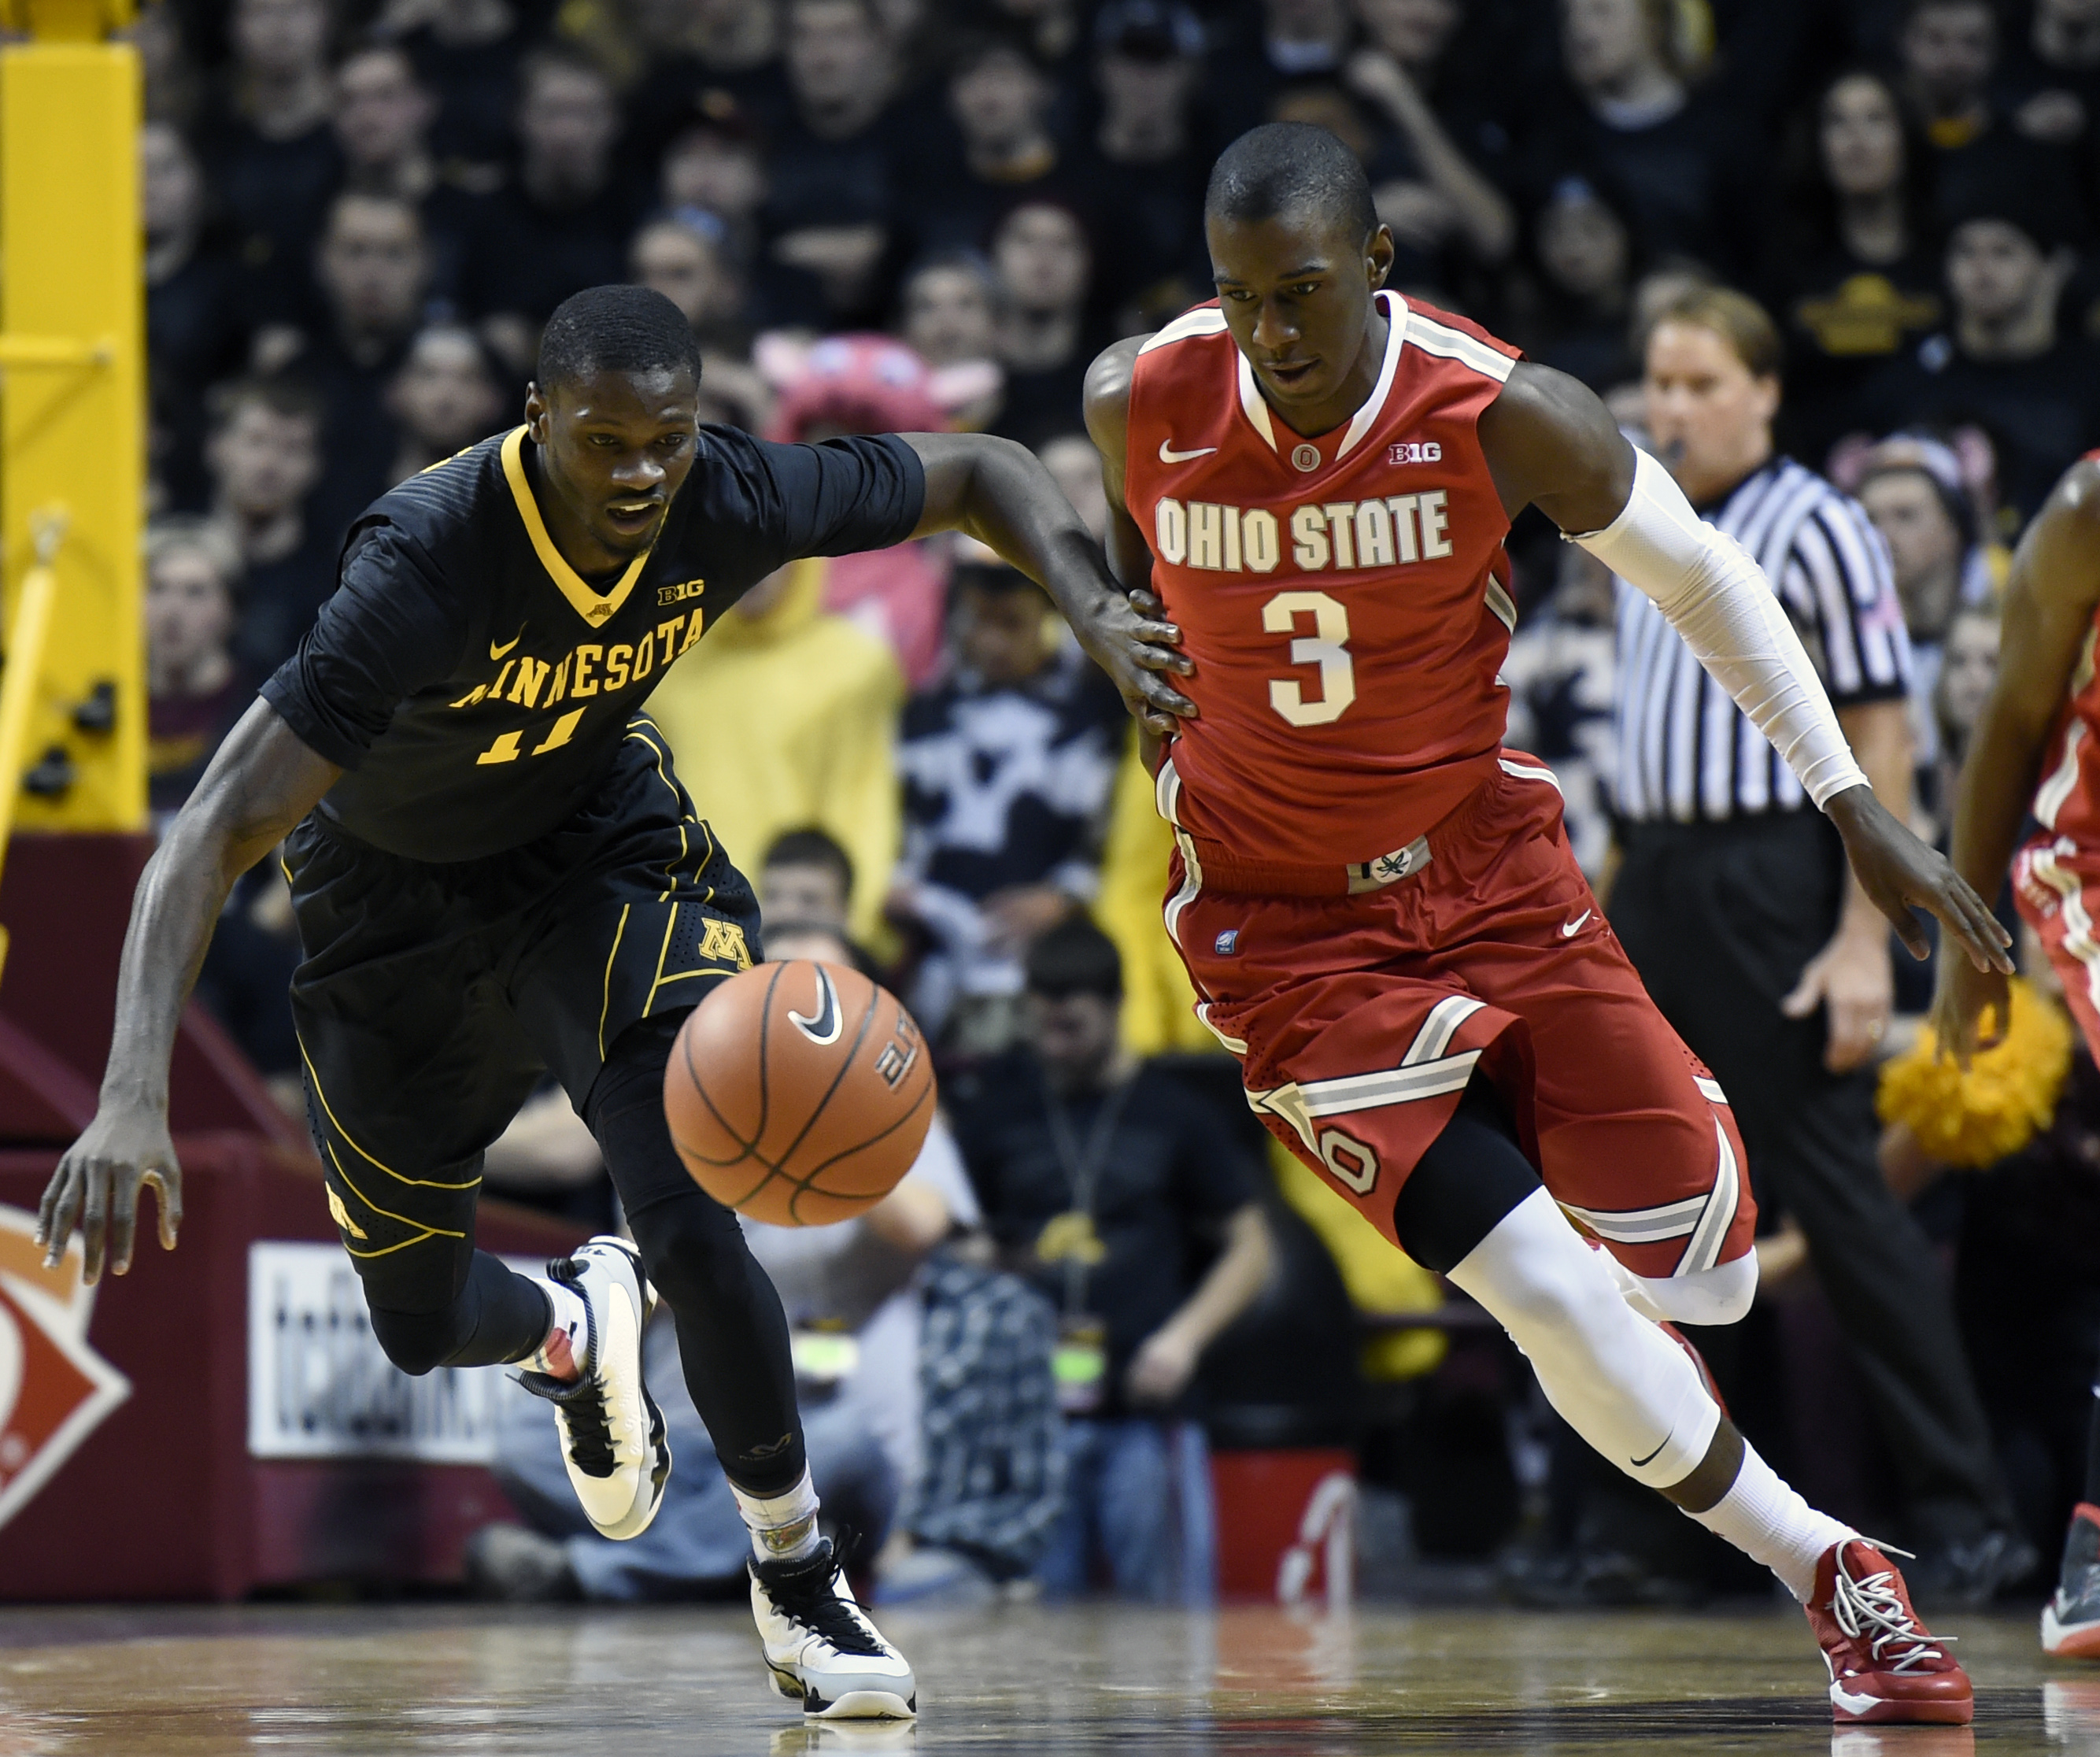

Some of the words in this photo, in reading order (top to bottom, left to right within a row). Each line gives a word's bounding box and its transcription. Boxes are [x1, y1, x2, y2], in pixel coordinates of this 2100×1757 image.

[1155, 496, 1280, 573] OHIO
[1289, 489, 1453, 571] STATE
[1261, 590, 1357, 727] 3
